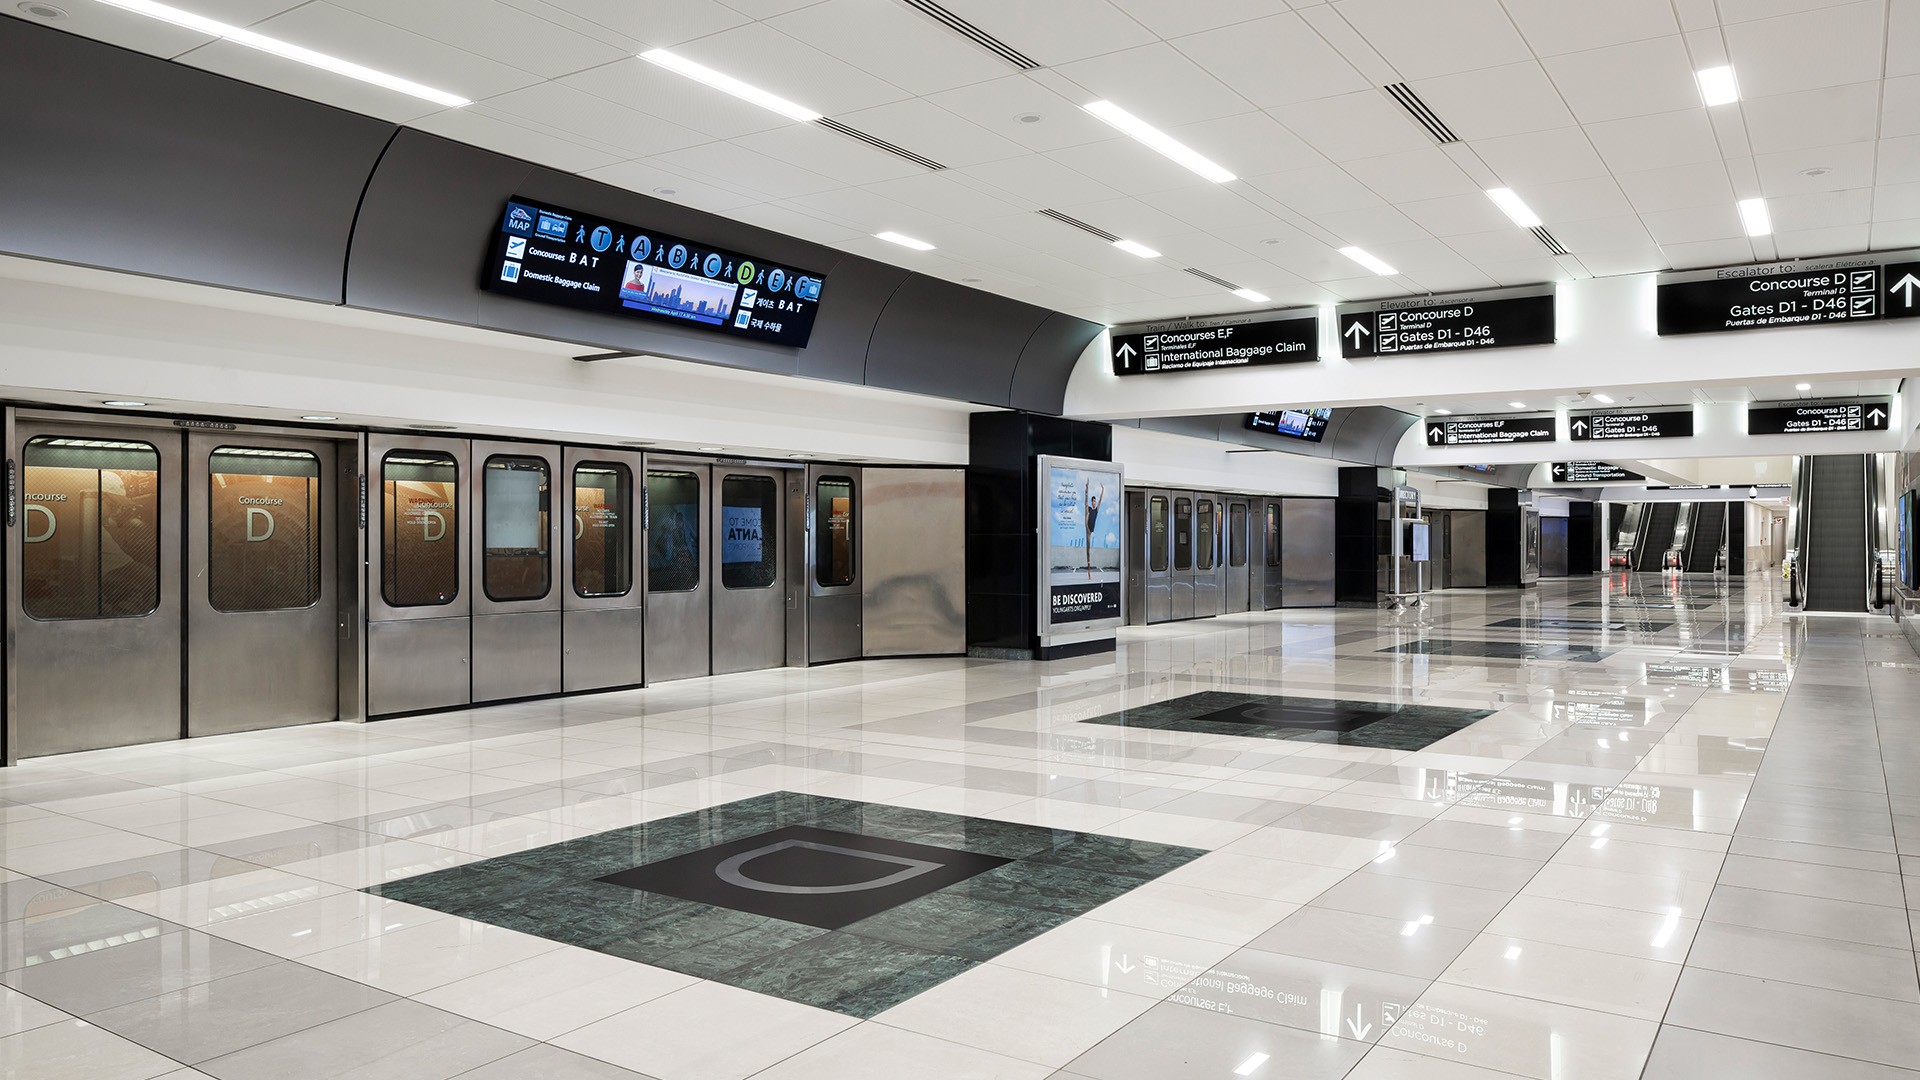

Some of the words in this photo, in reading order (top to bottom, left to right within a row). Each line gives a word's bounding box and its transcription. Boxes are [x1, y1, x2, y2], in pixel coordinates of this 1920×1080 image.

[508, 219, 530, 231] MAP
[528, 247, 566, 261] Concourses
[569, 252, 578, 264] B
[579, 254, 588, 266] A
[592, 257, 600, 268] T
[1717, 265, 1775, 279] Escalator
[1779, 264, 1796, 274] to:
[1836, 260, 1866, 268] Elétrica
[524, 270, 554, 283] Domestic
[554, 276, 582, 289] Baggage
[582, 282, 600, 292] Claim
[1750, 277, 1830, 292] Concourse
[1834, 274, 1846, 285] D
[1803, 288, 1838, 297] Terminal
[778, 300, 786, 310] B
[786, 302, 794, 311] A
[796, 304, 803, 313] T
[1380, 299, 1422, 310] Elevator
[1423, 298, 1437, 307] to:
[1730, 304, 1774, 317] Gates
[1778, 301, 1796, 313] D1
[1813, 297, 1846, 310] D46
[1400, 309, 1461, 323] Concourse
[1464, 306, 1474, 316] D
[1725, 318, 1755, 327] Puertas
[1769, 314, 1810, 324] Embarque
[1812, 313, 1821, 321] D1
[1828, 311, 1846, 319] D46
[1146, 324, 1165, 333] Train
[1174, 320, 1194, 330] Walk
[1196, 320, 1208, 328] to:
[1400, 322, 1425, 330] Terminal
[1400, 330, 1434, 343] Gates
[1437, 328, 1451, 340] D1
[1464, 325, 1490, 336] D46
[1160, 332, 1215, 344] Concourses
[1218, 328, 1234, 339] E,F
[1161, 348, 1223, 362] International
[1226, 345, 1272, 359] Baggage
[1275, 342, 1306, 354] Claim
[1400, 343, 1423, 352] Puertas
[1433, 340, 1466, 349] Embarque
[1162, 362, 1184, 370] Reclamo
[1192, 360, 1214, 368] Equipaje
[1214, 357, 1249, 366] Internacional
[239, 496, 283, 505] Concourse
[24, 504, 56, 542] D
[247, 508, 274, 541] D
[424, 511, 446, 541] D
[1053, 595, 1061, 606] BE
[1063, 592, 1102, 605] DISCOVERED
[715, 839, 946, 894] D
